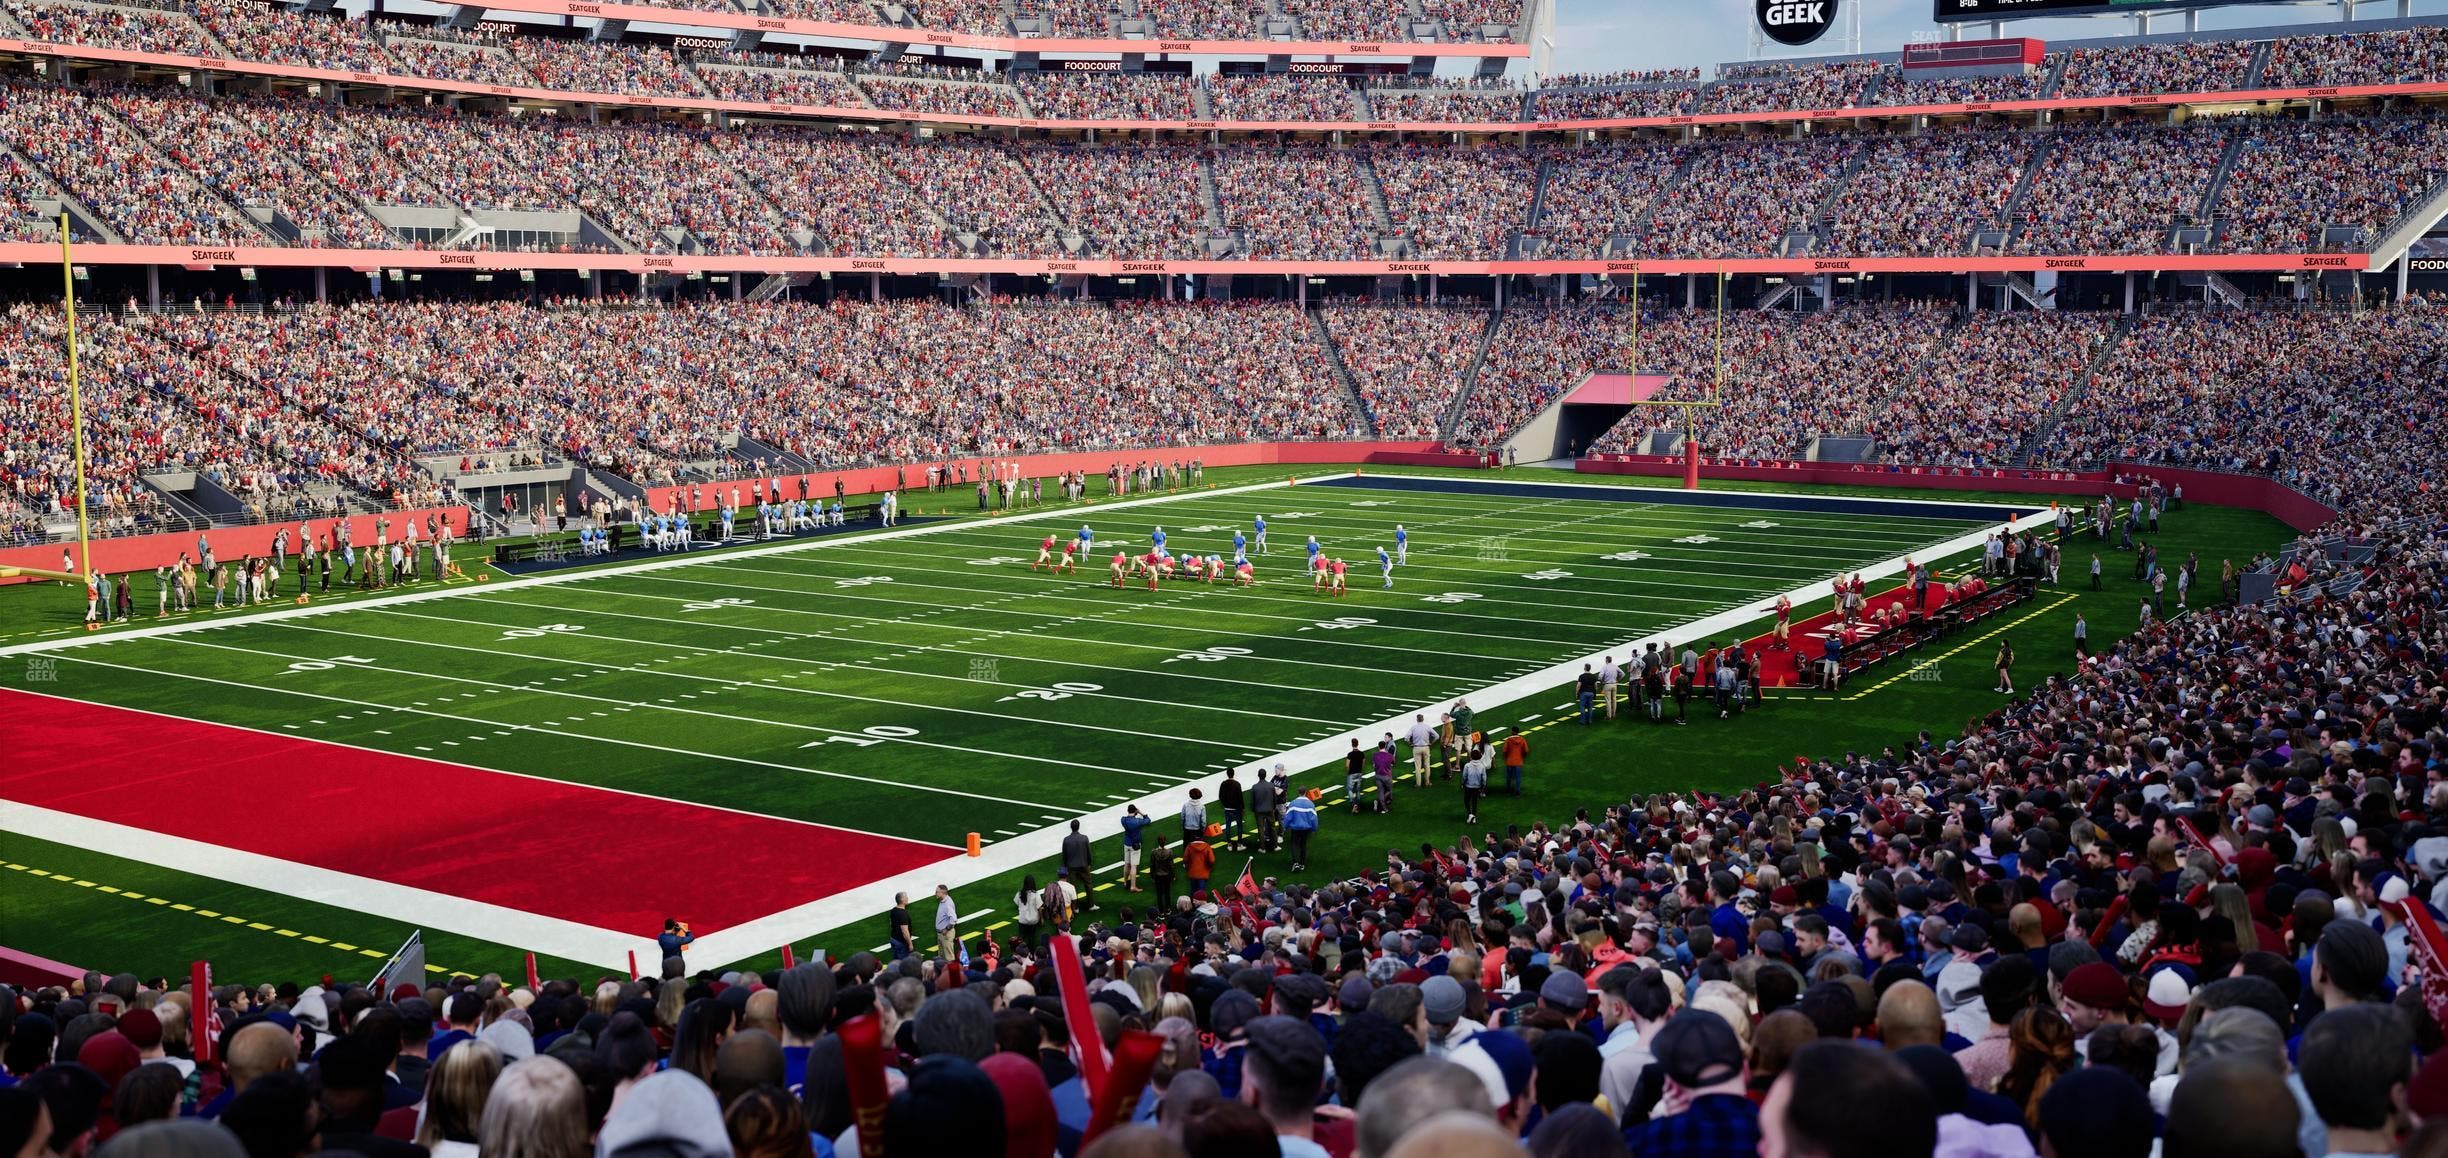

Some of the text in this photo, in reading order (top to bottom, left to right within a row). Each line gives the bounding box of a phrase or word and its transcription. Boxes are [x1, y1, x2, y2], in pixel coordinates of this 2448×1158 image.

[568, 4, 600, 13] SEATGEEK
[1766, 2, 1824, 26] GEEK
[758, 20, 786, 29] SEATGEEK
[675, 37, 732, 48] FOODCOURT
[1160, 43, 1191, 51] SEATGEEK
[199, 59, 226, 68] SEATGEEK
[1065, 62, 1121, 71] FOODCOURT
[192, 250, 235, 261] SEATGEEK
[440, 255, 475, 264] SEATGEEK
[643, 258, 673, 267] SEATGEEK
[852, 261, 885, 269] SEATGEEK
[1814, 261, 1850, 269] SEATGEEK
[2045, 259, 2085, 267] SEATGEEK
[2303, 257, 2347, 266] SEATGEEK
[2411, 260, 2448, 270] FOOD
[1122, 263, 1165, 271] SEATGEEK
[1314, 617, 1378, 629] 40
[1176, 647, 1254, 661] 30
[1016, 682, 1104, 700] 20
[825, 726, 920, 746] 10
